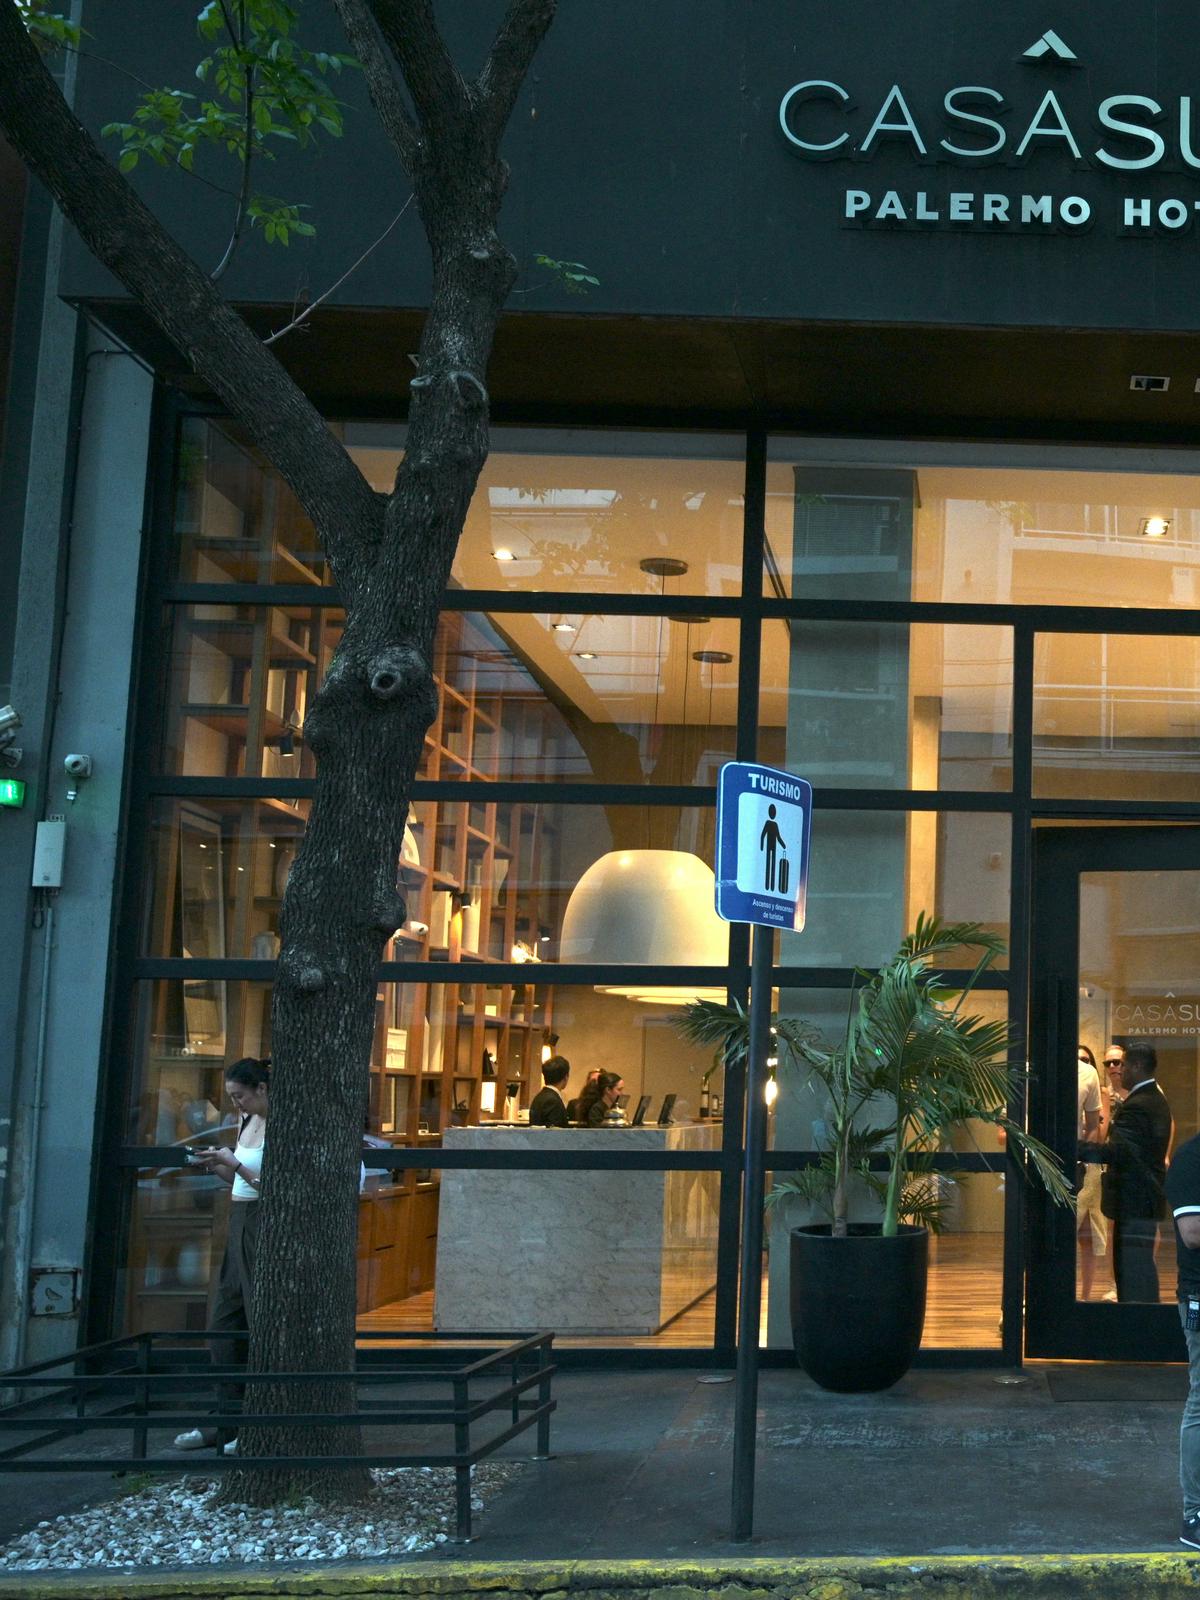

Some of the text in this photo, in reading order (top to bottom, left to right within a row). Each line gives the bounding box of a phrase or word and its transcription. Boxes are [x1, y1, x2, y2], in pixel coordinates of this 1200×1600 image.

[845, 189, 1092, 225] PALERMO
[748, 772, 801, 801] TURISMO
[752, 898, 771, 910] Ascenso
[775, 903, 794, 913] descenso
[762, 911, 785, 922] de turistas
[1128, 1027, 1177, 1035] PALERMO
